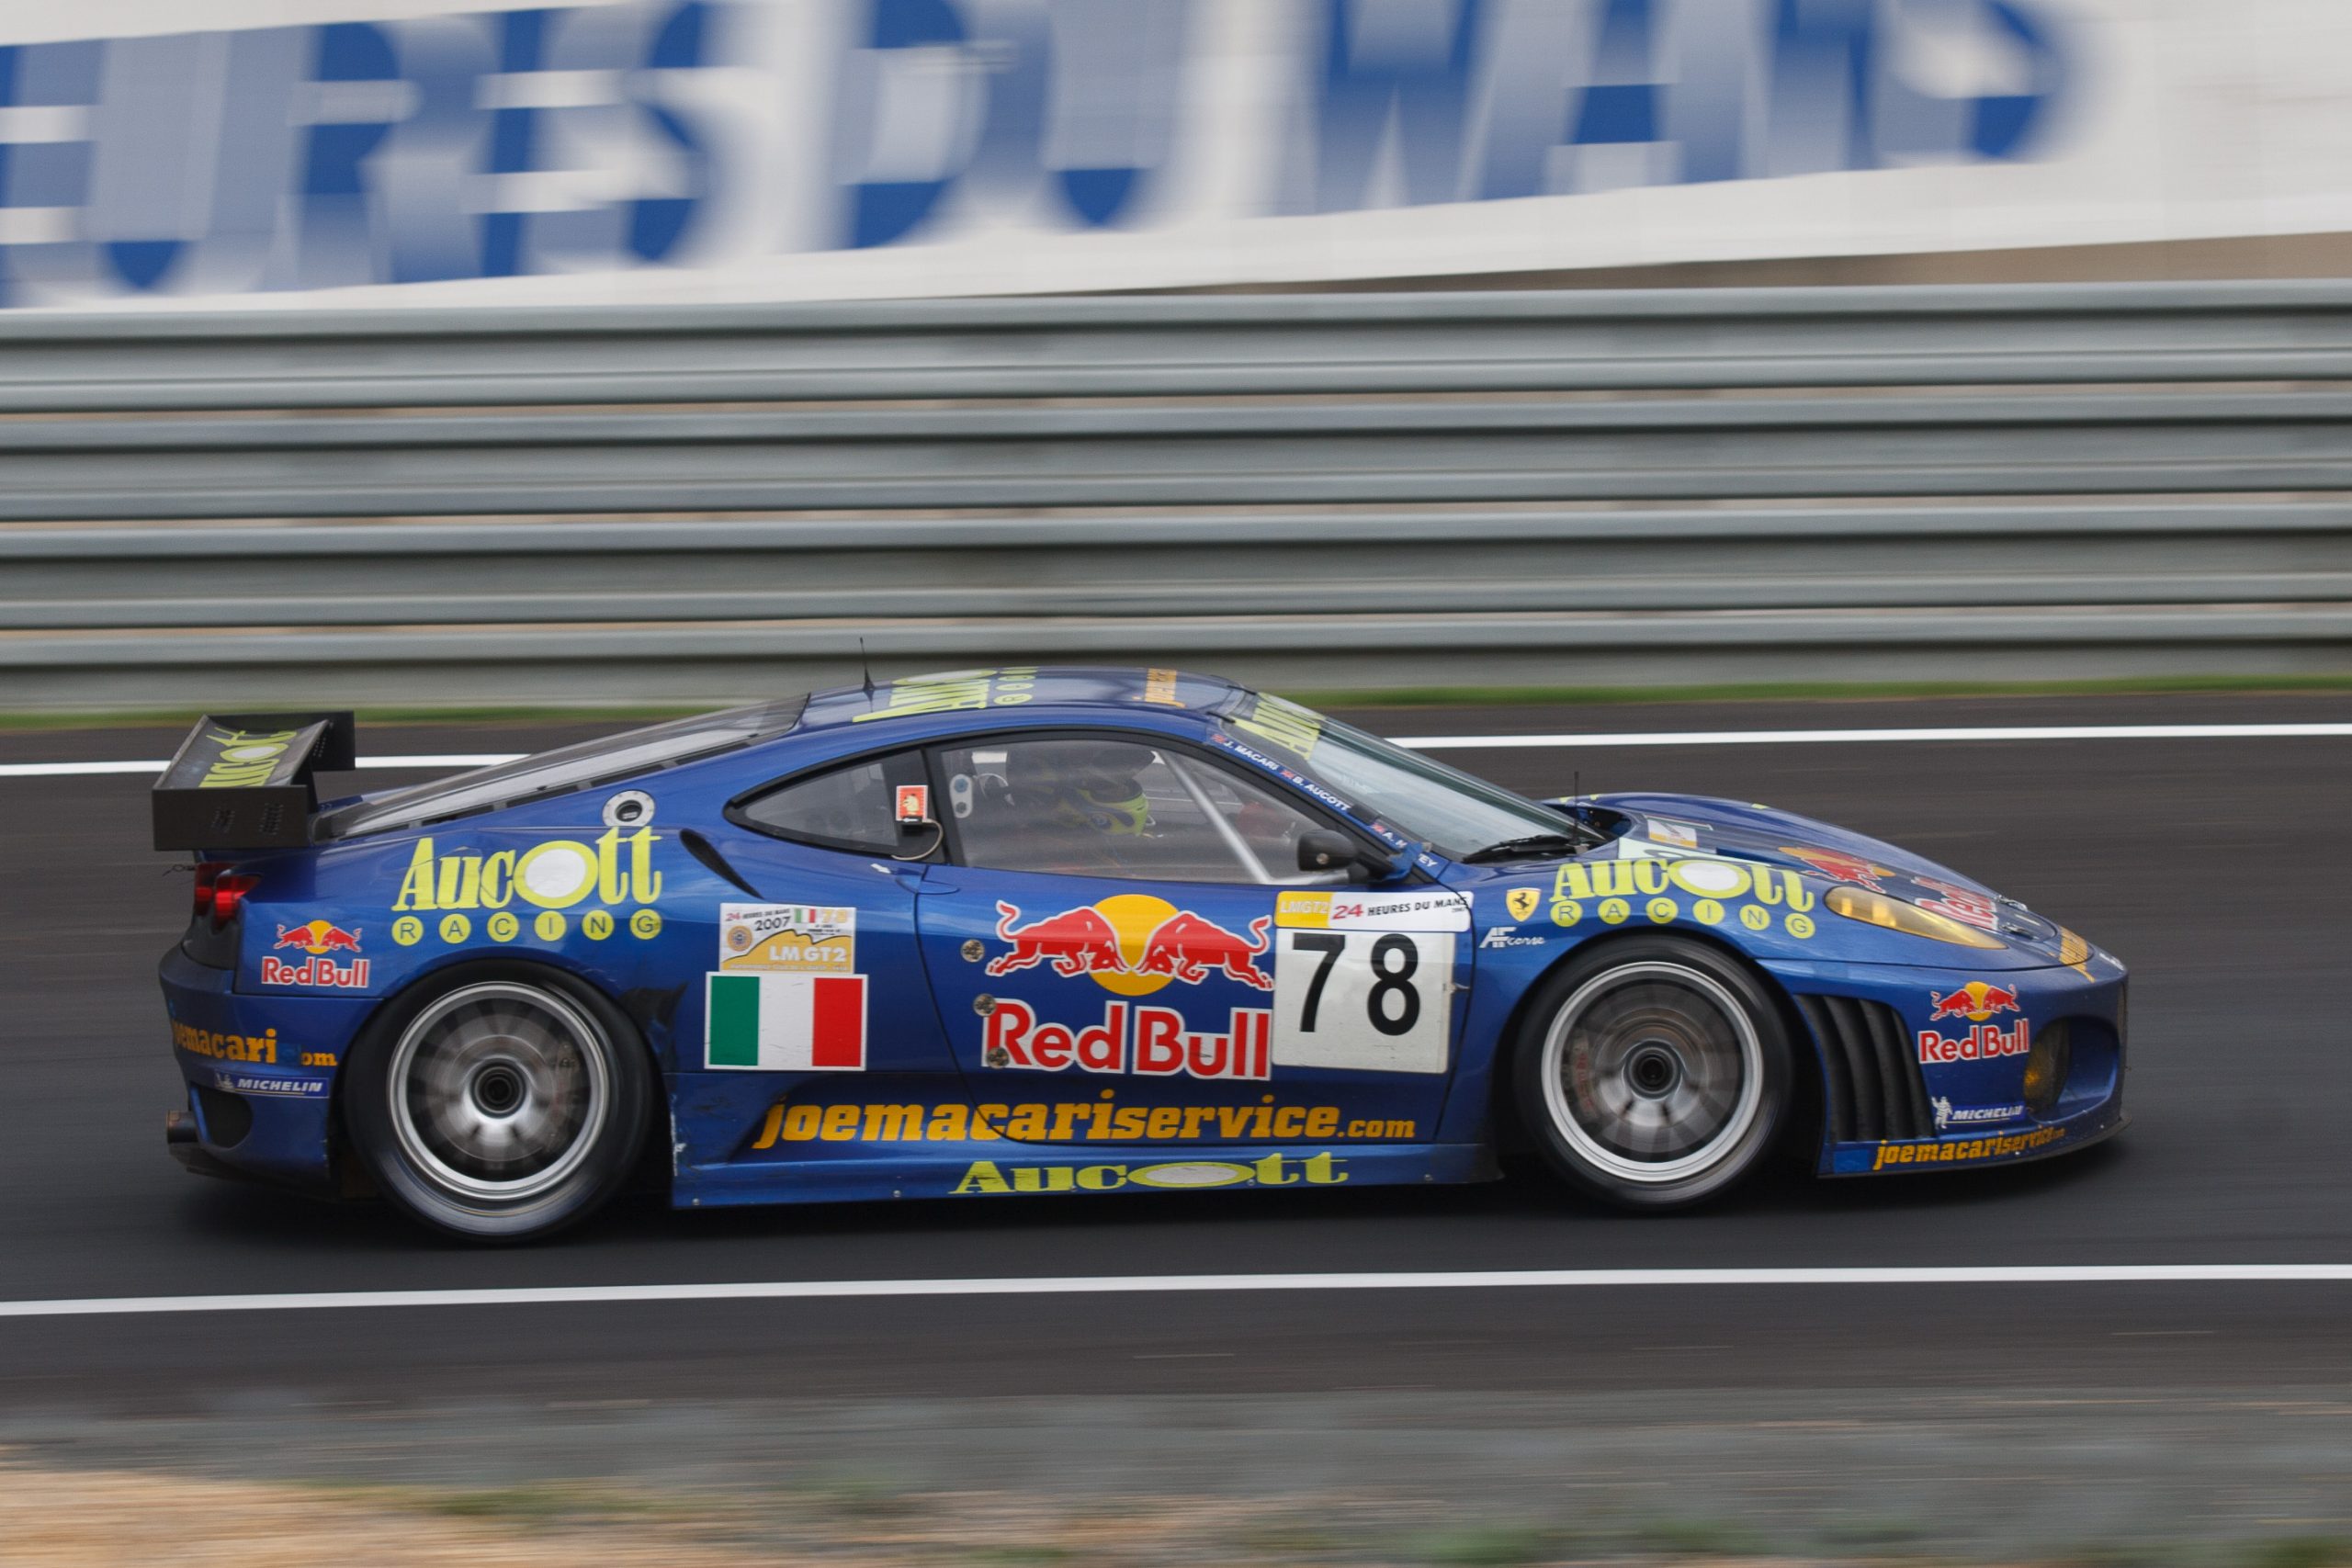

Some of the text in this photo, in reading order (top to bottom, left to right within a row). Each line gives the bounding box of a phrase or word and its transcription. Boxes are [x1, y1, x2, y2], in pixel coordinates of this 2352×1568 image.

[1235, 744, 1278, 772] MACARI
[1305, 782, 1351, 812] AUCOTT
[391, 826, 662, 911] Aucott
[395, 911, 659, 943] RACING
[754, 916, 791, 931] 2007
[1280, 900, 1329, 915] LMGT2
[1332, 896, 1468, 919] 24 HEURES DU MANS
[1553, 898, 1812, 937] RACING
[261, 956, 370, 988] Red Bull
[1292, 931, 1420, 1036] 78
[981, 998, 1272, 1081] Red Bull
[1918, 1018, 2030, 1064] Red Bull
[236, 1077, 323, 1093] MICHELIN
[752, 1089, 1415, 1150] joemacariservice.com
[1952, 1105, 2024, 1121] MICHELIN
[948, 1151, 1348, 1194] Aucott
